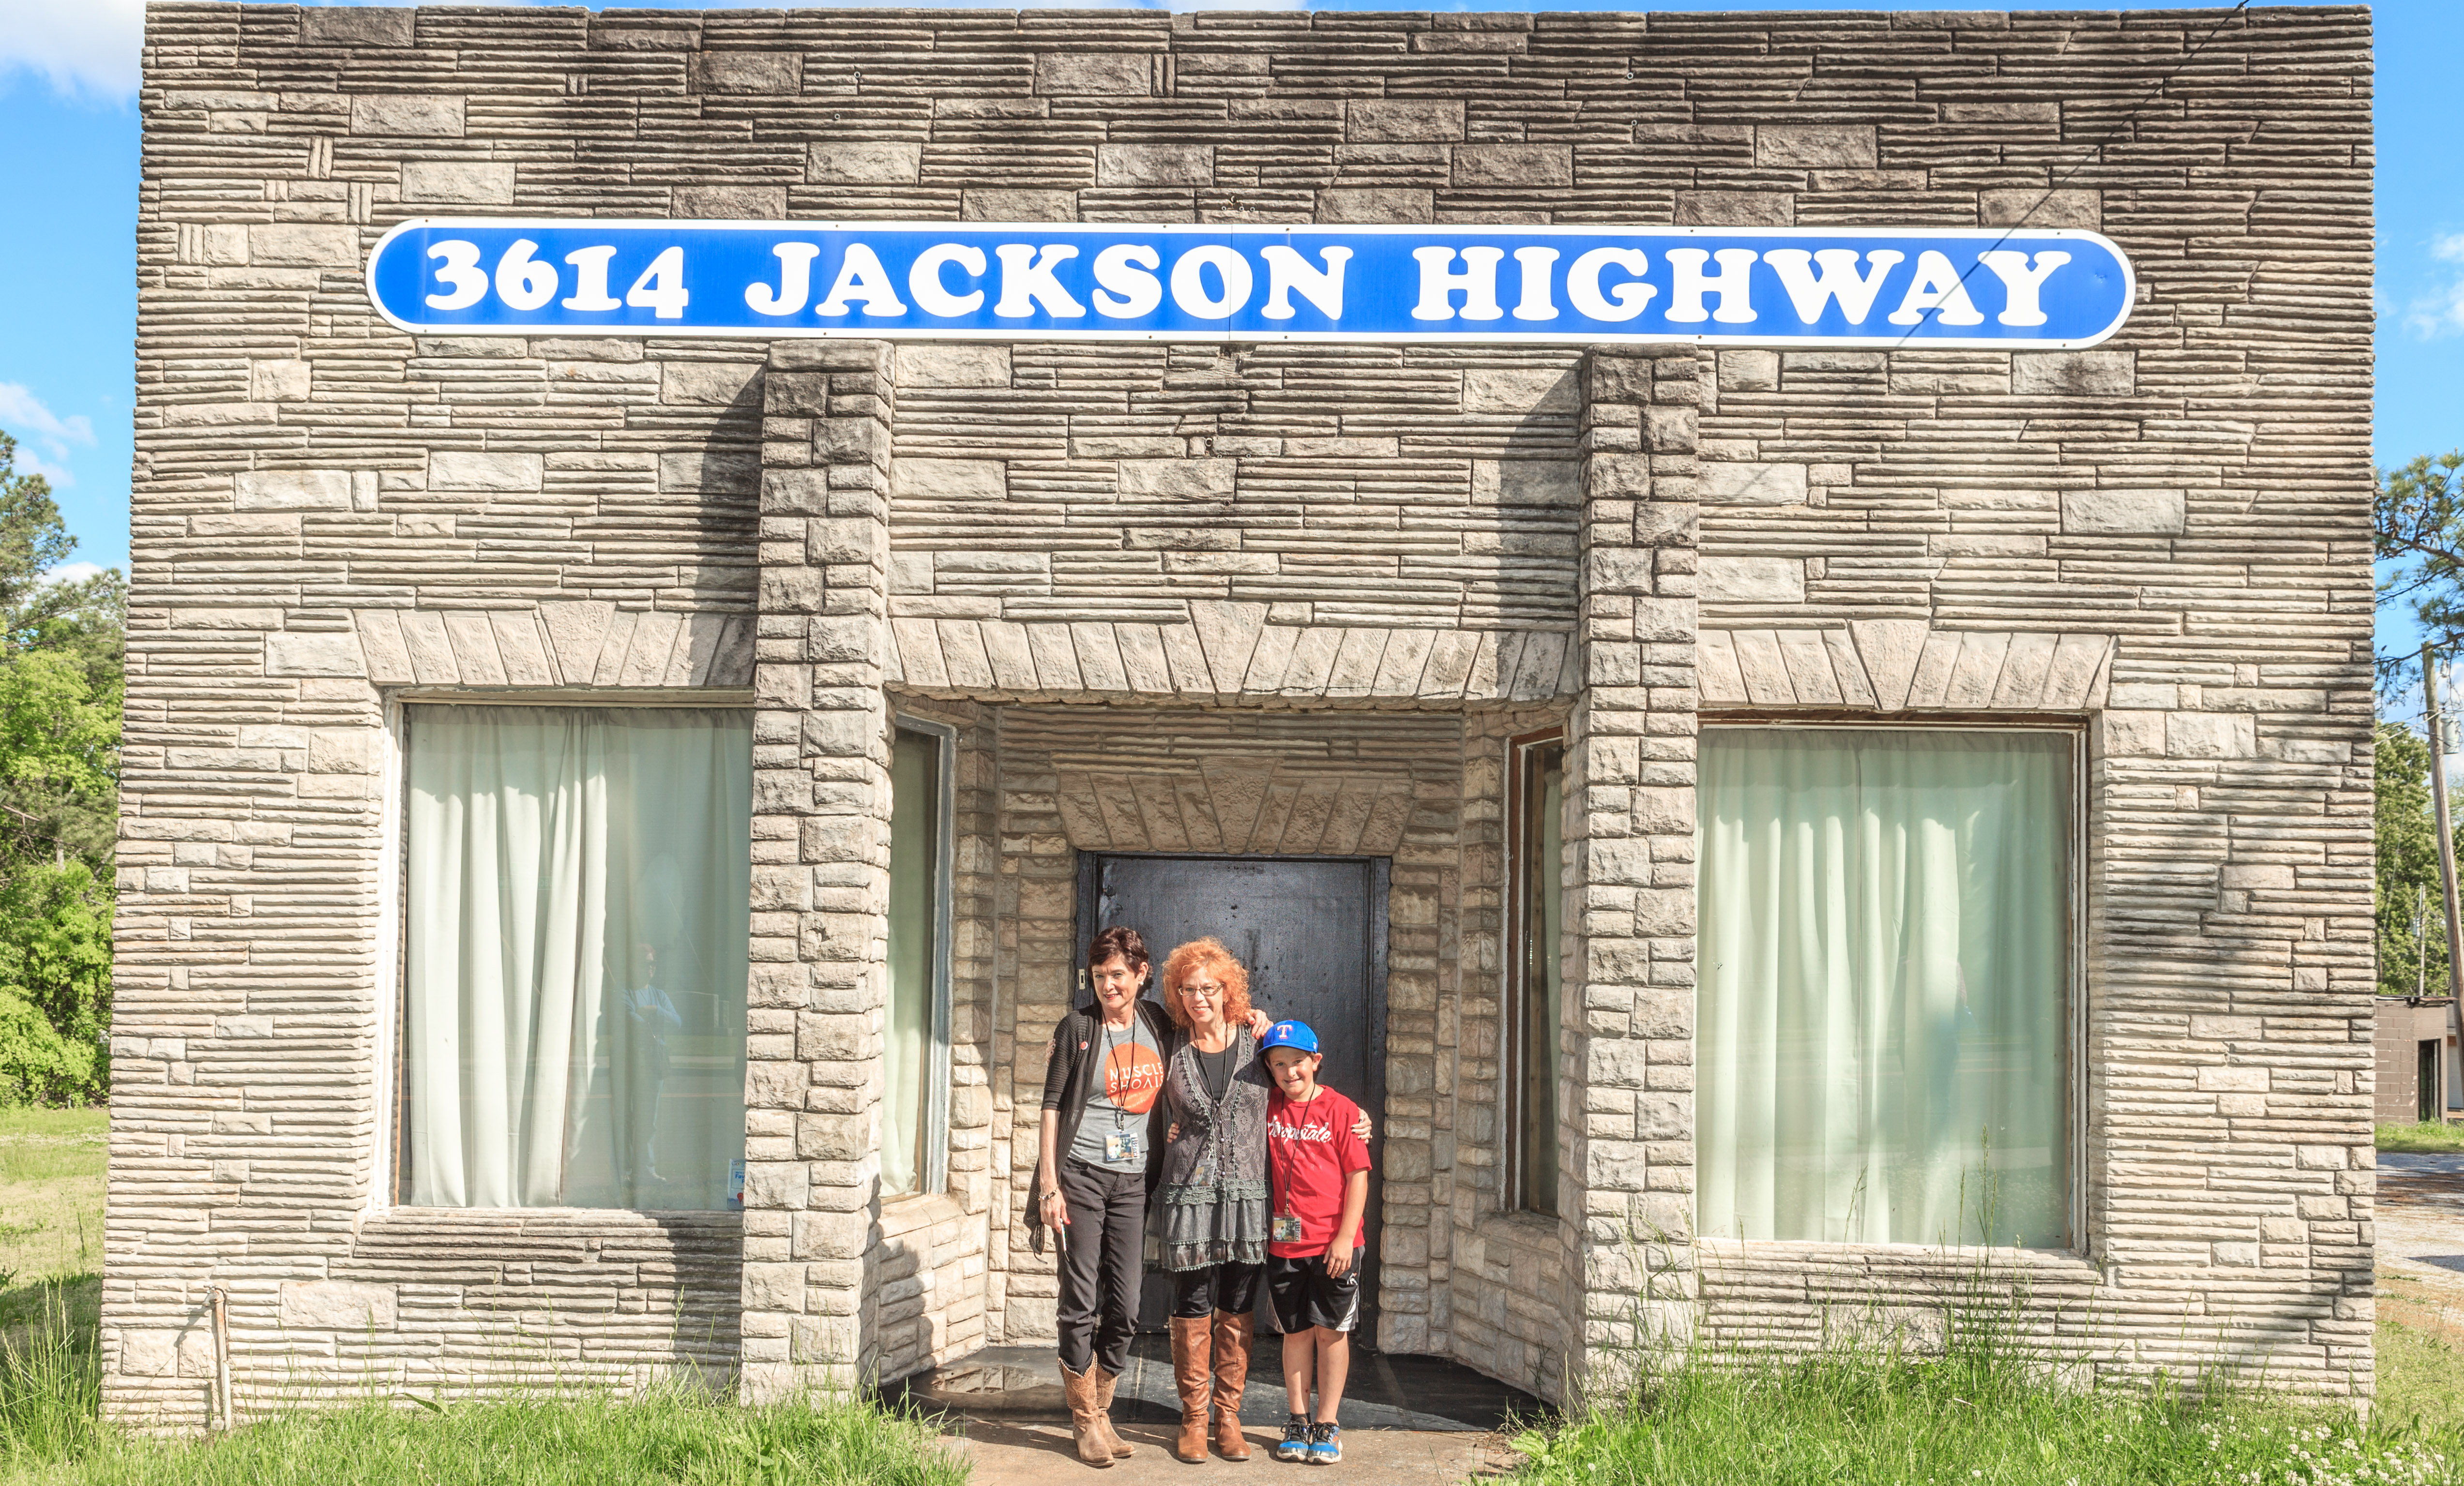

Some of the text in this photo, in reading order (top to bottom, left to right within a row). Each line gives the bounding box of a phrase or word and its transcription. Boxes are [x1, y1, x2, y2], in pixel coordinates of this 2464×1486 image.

[425, 239, 2072, 327] 3614 JACKSON HIGHWAY
[1276, 1024, 1293, 1039] T
[1110, 1063, 1164, 1081] MUSCLE
